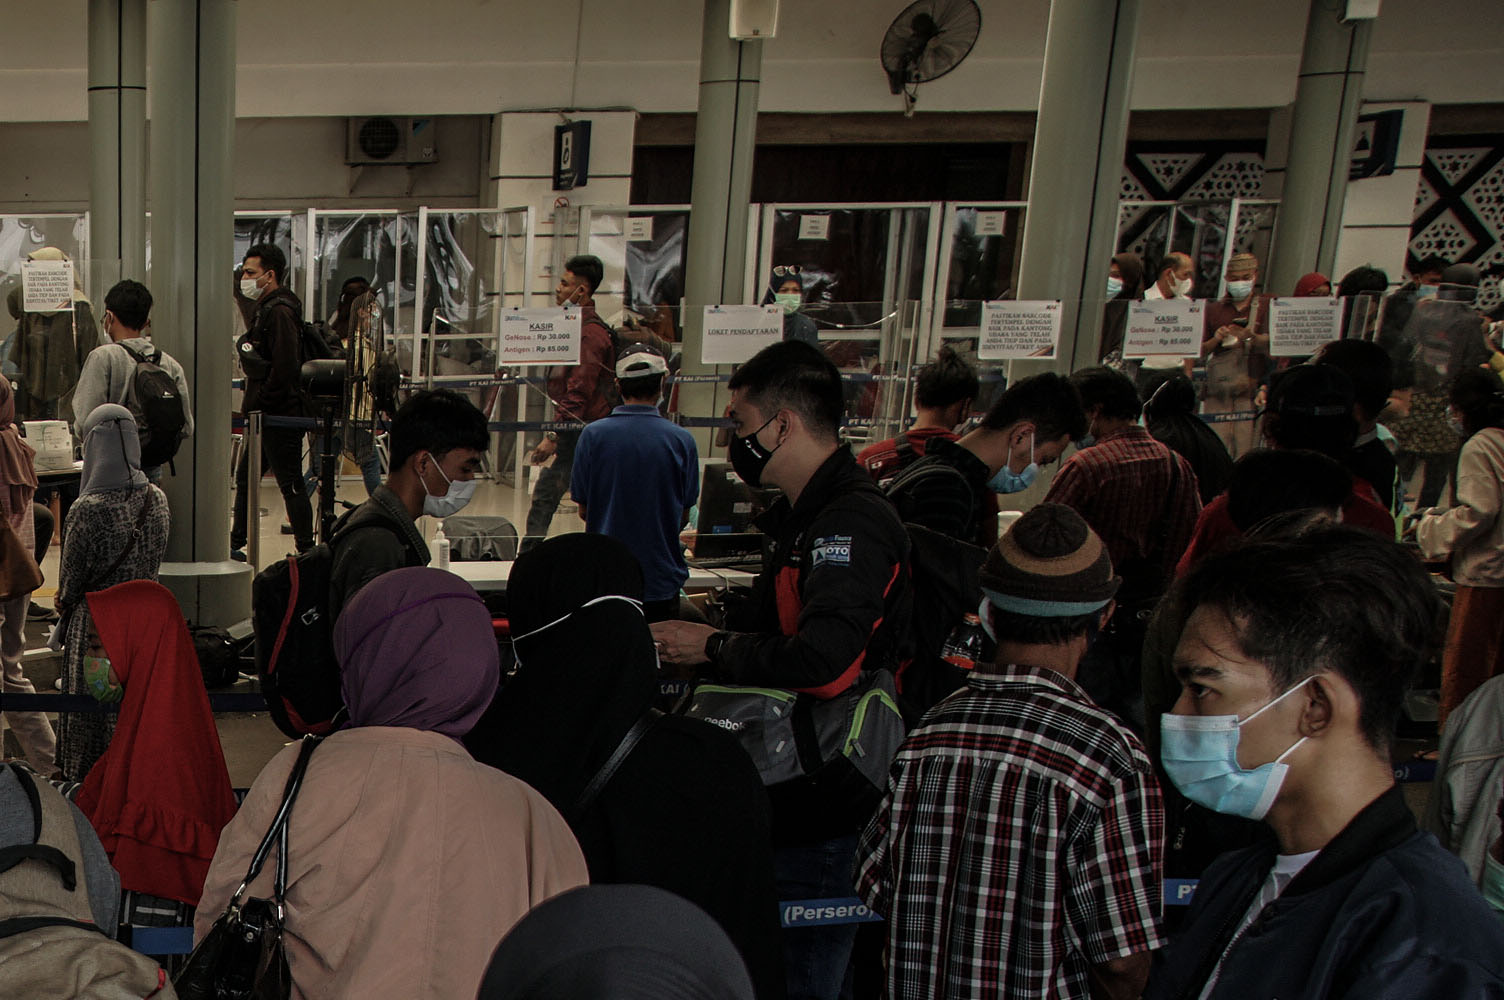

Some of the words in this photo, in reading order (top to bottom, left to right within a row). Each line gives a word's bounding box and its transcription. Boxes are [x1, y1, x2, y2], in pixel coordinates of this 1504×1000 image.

[1161, 326, 1171, 334] Rp
[504, 346, 531, 354] Antigen
[784, 904, 875, 925] (Persero)
